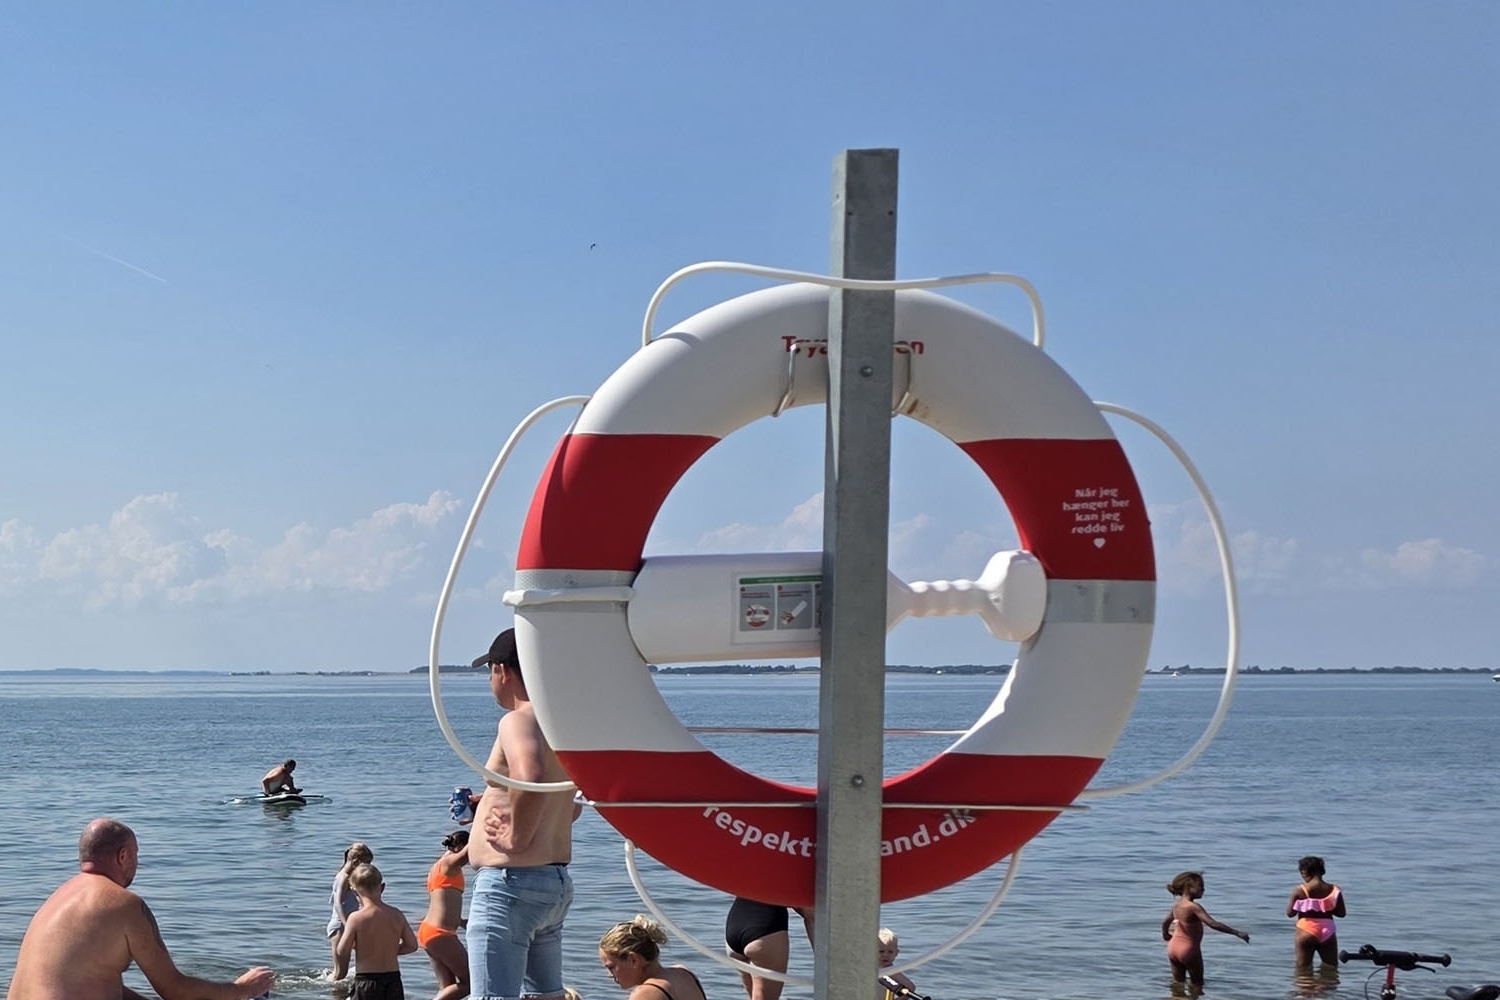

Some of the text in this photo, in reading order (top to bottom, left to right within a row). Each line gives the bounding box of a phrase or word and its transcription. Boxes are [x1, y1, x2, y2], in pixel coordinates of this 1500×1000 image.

[1075, 487, 1118, 498] Når jeg
[1062, 498, 1130, 511] hænger her
[1075, 511, 1120, 522] kan jeg
[1071, 522, 1125, 534] redde liv
